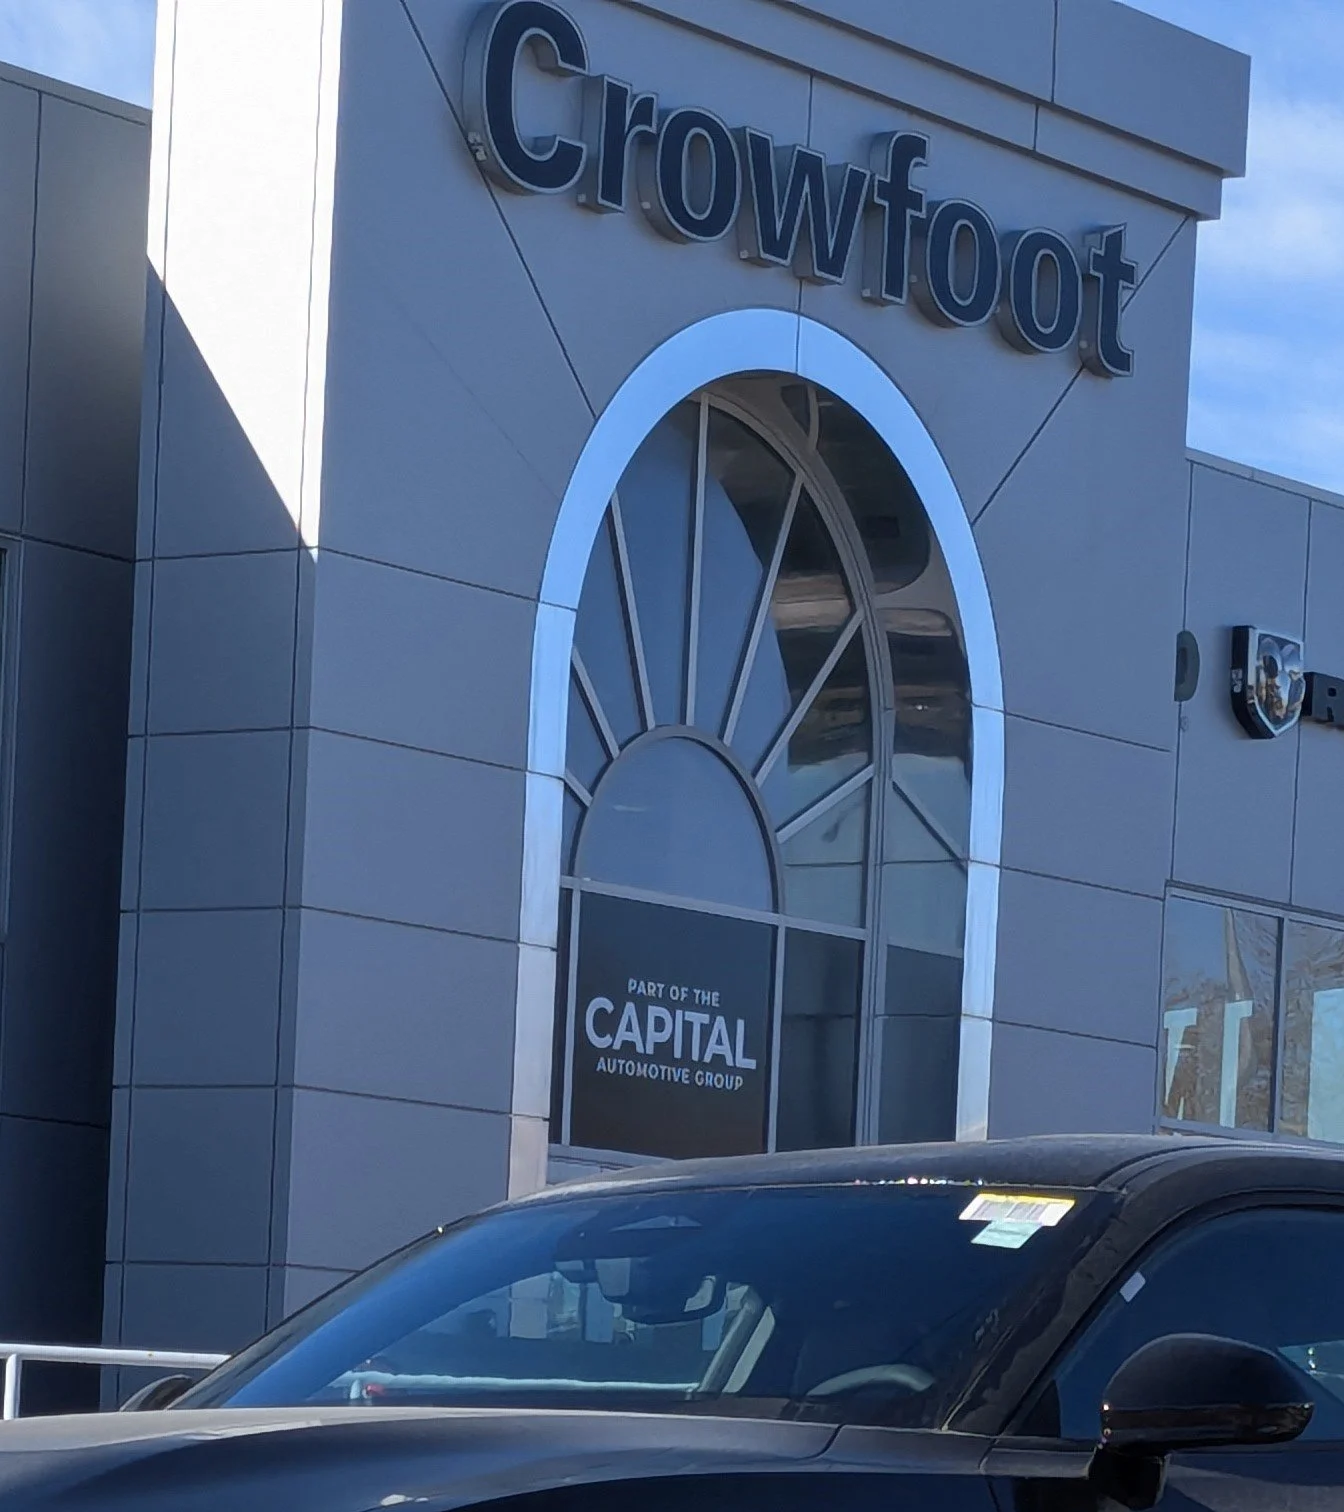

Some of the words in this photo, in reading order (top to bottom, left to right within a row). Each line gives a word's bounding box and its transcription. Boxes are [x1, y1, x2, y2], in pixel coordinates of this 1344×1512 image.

[468, 0, 1137, 377] Crowfoot
[627, 977, 666, 999] PART
[669, 984, 689, 1002] OF
[694, 988, 721, 1008] THE
[585, 996, 757, 1070] CAPITAL
[596, 1056, 691, 1085] AUTOMOTIVE
[694, 1070, 744, 1091] GROUP
